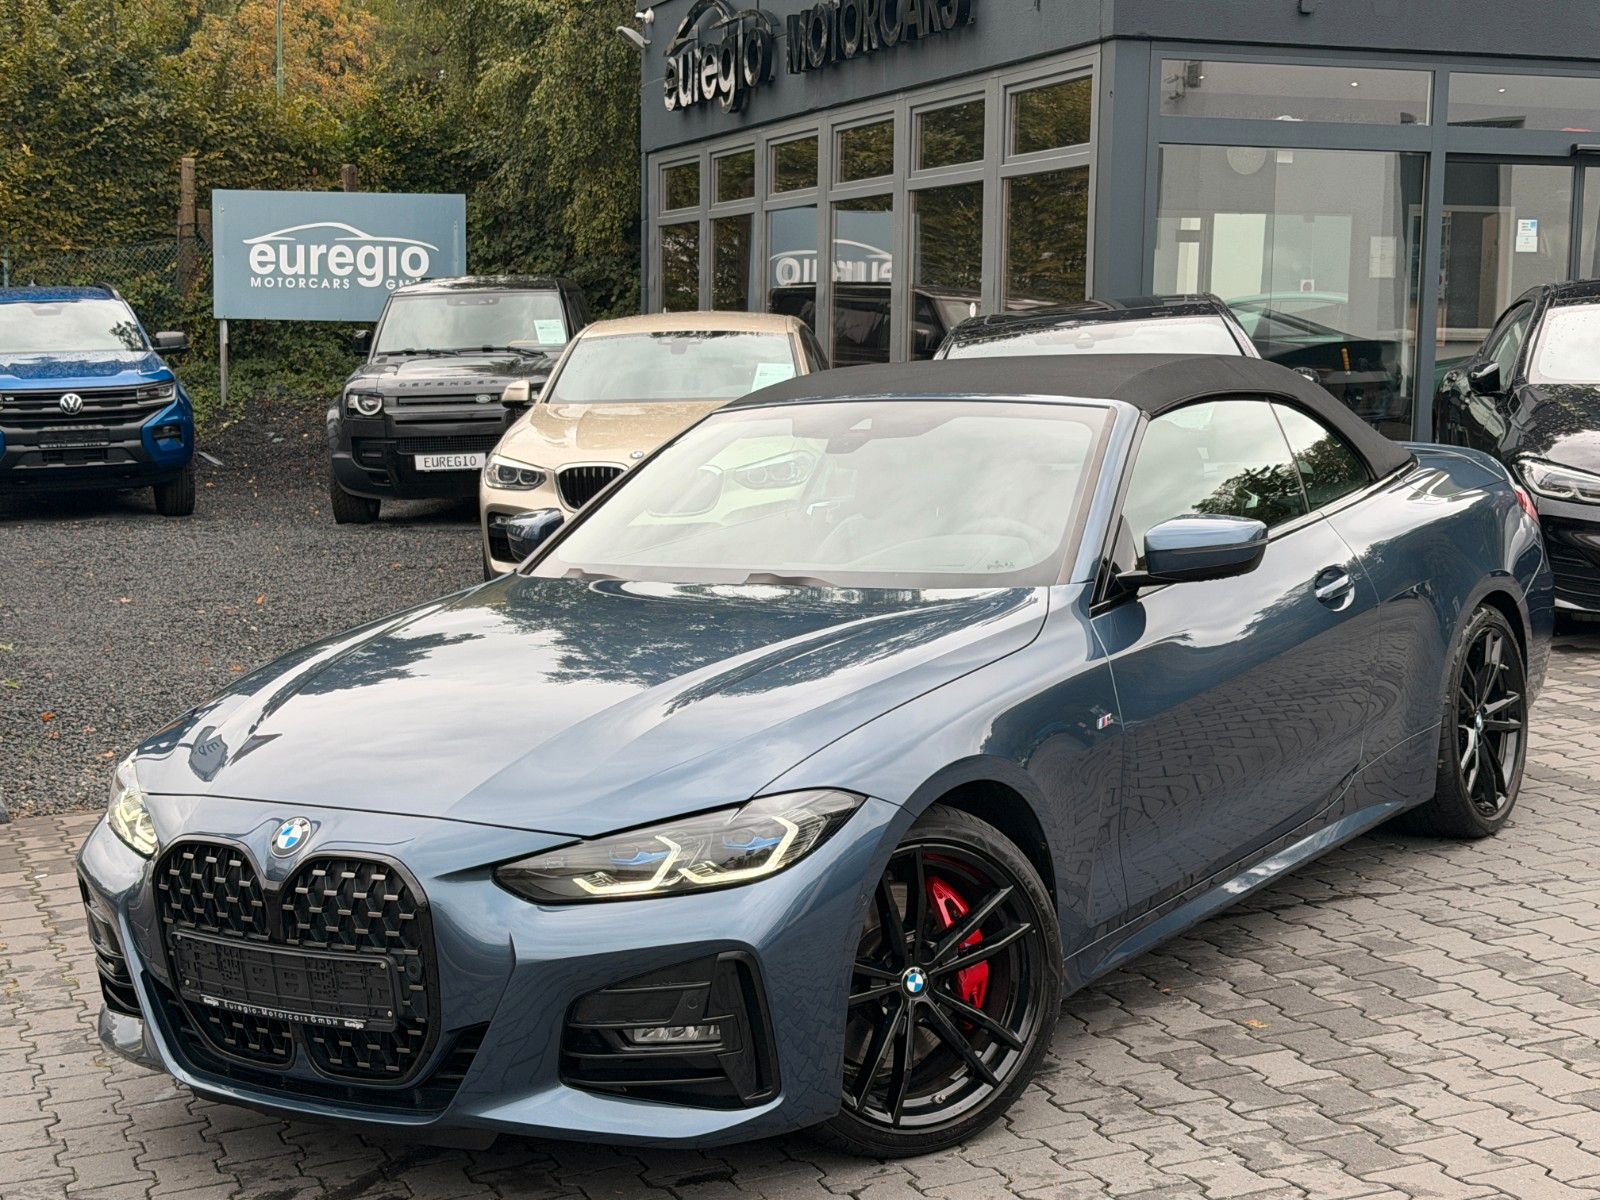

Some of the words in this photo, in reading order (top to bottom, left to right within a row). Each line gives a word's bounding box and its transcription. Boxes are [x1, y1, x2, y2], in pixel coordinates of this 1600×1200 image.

[249, 243, 430, 287] euregio
[250, 277, 350, 289] MOTORCARS
[424, 456, 477, 468] EUREGIO
